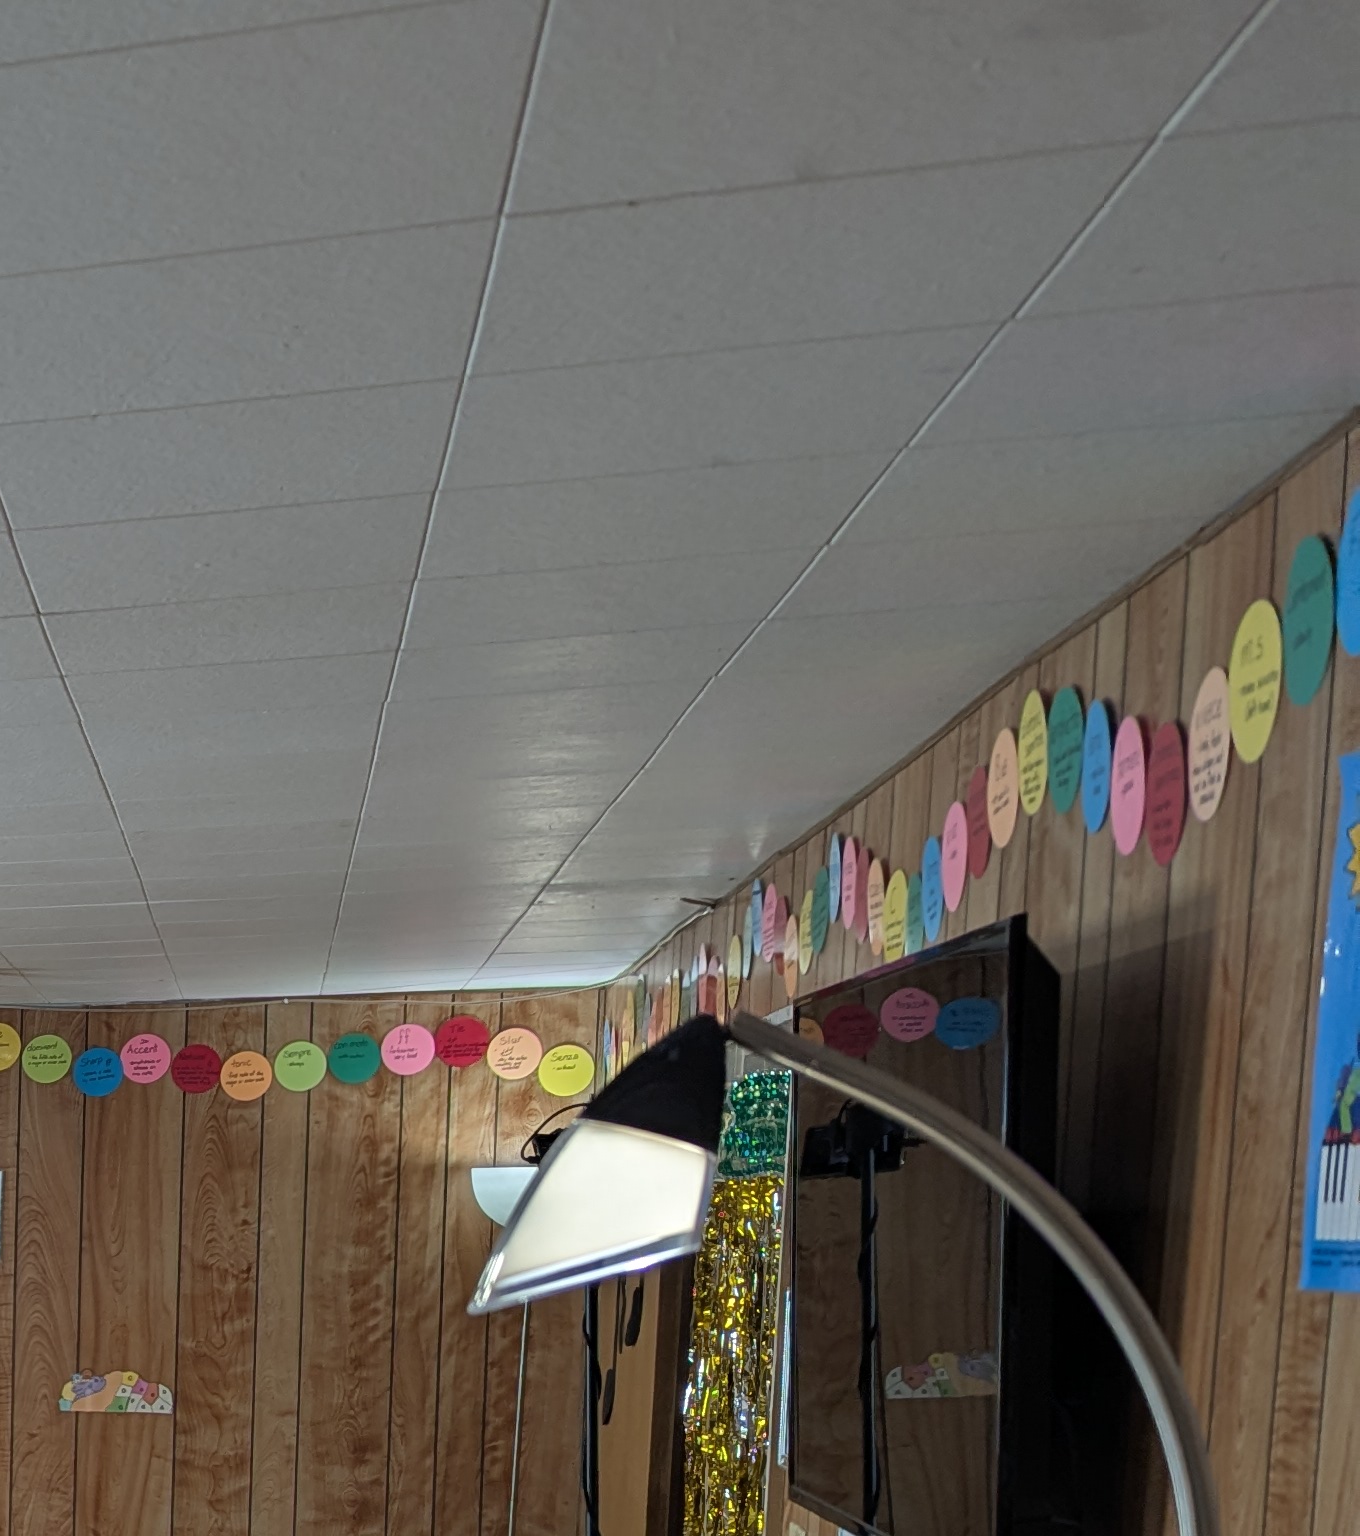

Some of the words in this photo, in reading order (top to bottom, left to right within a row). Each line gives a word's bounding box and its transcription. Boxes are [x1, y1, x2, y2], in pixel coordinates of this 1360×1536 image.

[499, 1036, 523, 1046] Slur
[127, 1044, 158, 1054] Accent
[79, 1056, 103, 1067] Sharp
[230, 1059, 252, 1069] tonic
